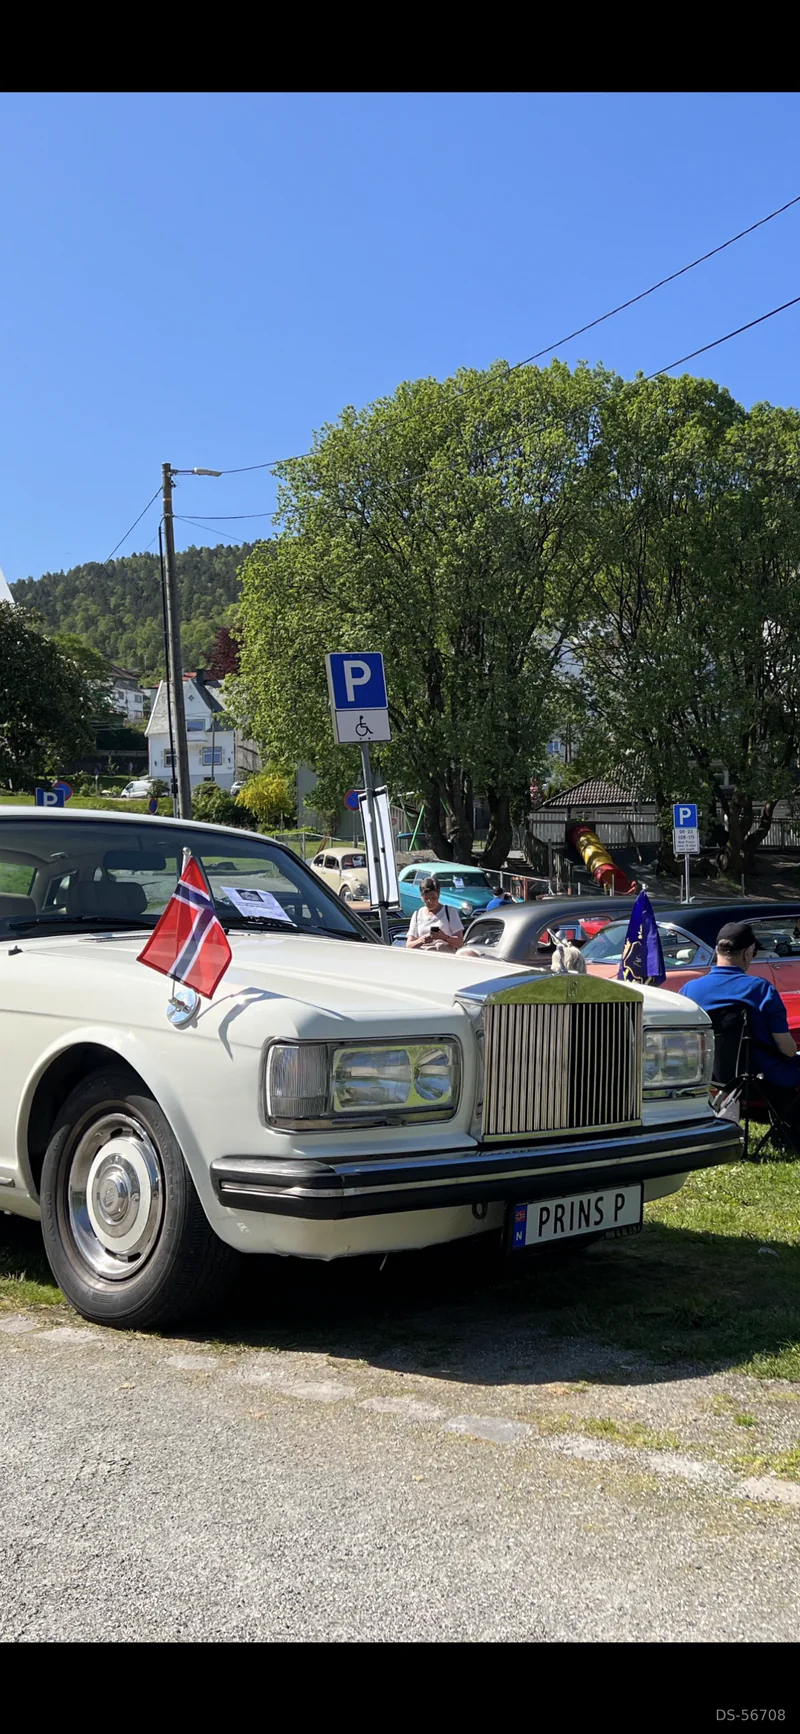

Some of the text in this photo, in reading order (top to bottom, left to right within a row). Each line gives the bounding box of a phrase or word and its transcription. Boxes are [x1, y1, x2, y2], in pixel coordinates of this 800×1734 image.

[343, 660, 372, 702] P
[43, 792, 58, 807] P
[679, 807, 692, 825] P
[538, 1196, 604, 1237] PRINS
[614, 1193, 625, 1222] P
[516, 1231, 523, 1241] N
